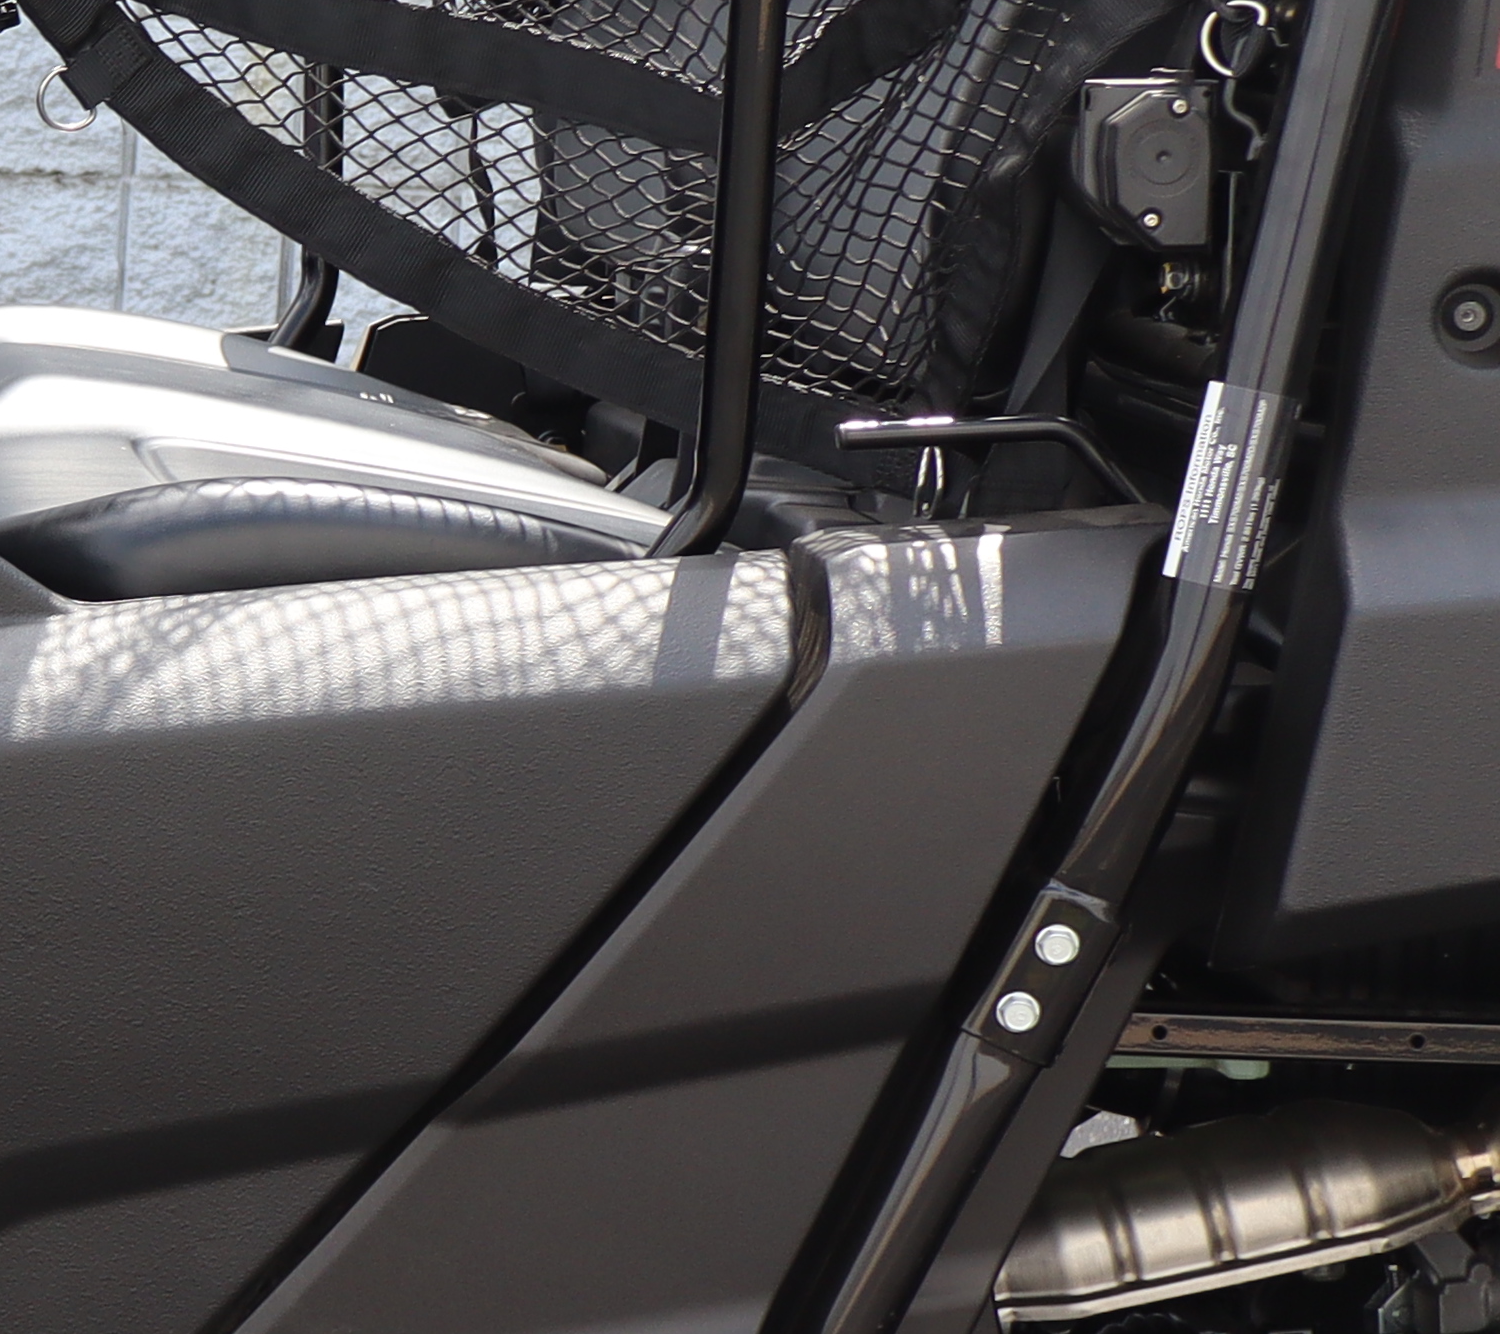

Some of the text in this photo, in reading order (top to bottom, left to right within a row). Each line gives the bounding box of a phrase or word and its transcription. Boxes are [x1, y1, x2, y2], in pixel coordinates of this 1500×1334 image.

[1173, 412, 1212, 541] ROPS Information
[1199, 443, 1228, 519] 1111 Honda Way
[1224, 442, 1238, 457] SC
[1181, 507, 1199, 552] American
[1192, 475, 1207, 506] Honda
[1200, 447, 1214, 474] Motor
